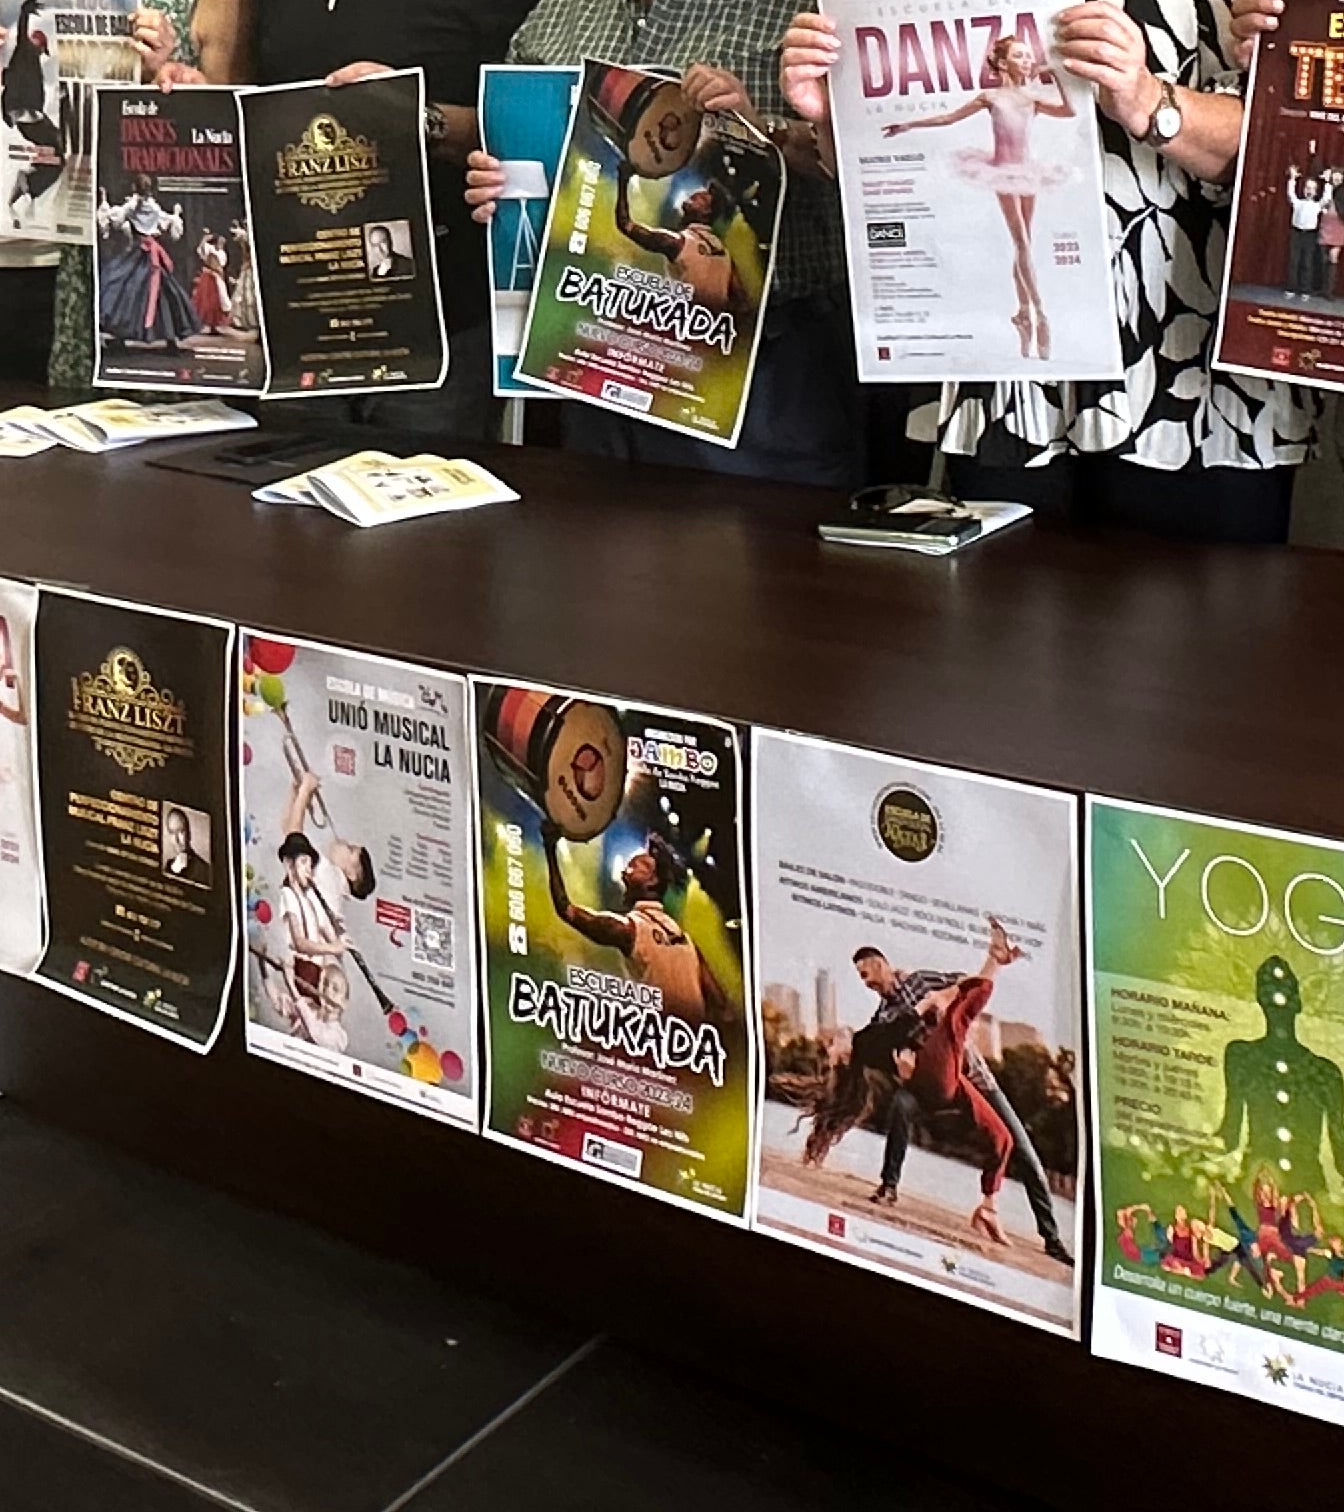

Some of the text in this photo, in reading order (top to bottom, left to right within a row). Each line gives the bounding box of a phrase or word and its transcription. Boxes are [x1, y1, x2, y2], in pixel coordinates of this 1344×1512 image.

[855, 12, 1055, 99] DANZA
[556, 265, 739, 355] BATUKADA
[328, 698, 450, 751] UNIÓ MUSICAL
[374, 741, 451, 784] LA NUCIA
[567, 965, 664, 1010] ESCUELA DE
[509, 972, 727, 1087] BATUKADA
[1166, 1277, 1183, 1299] un
